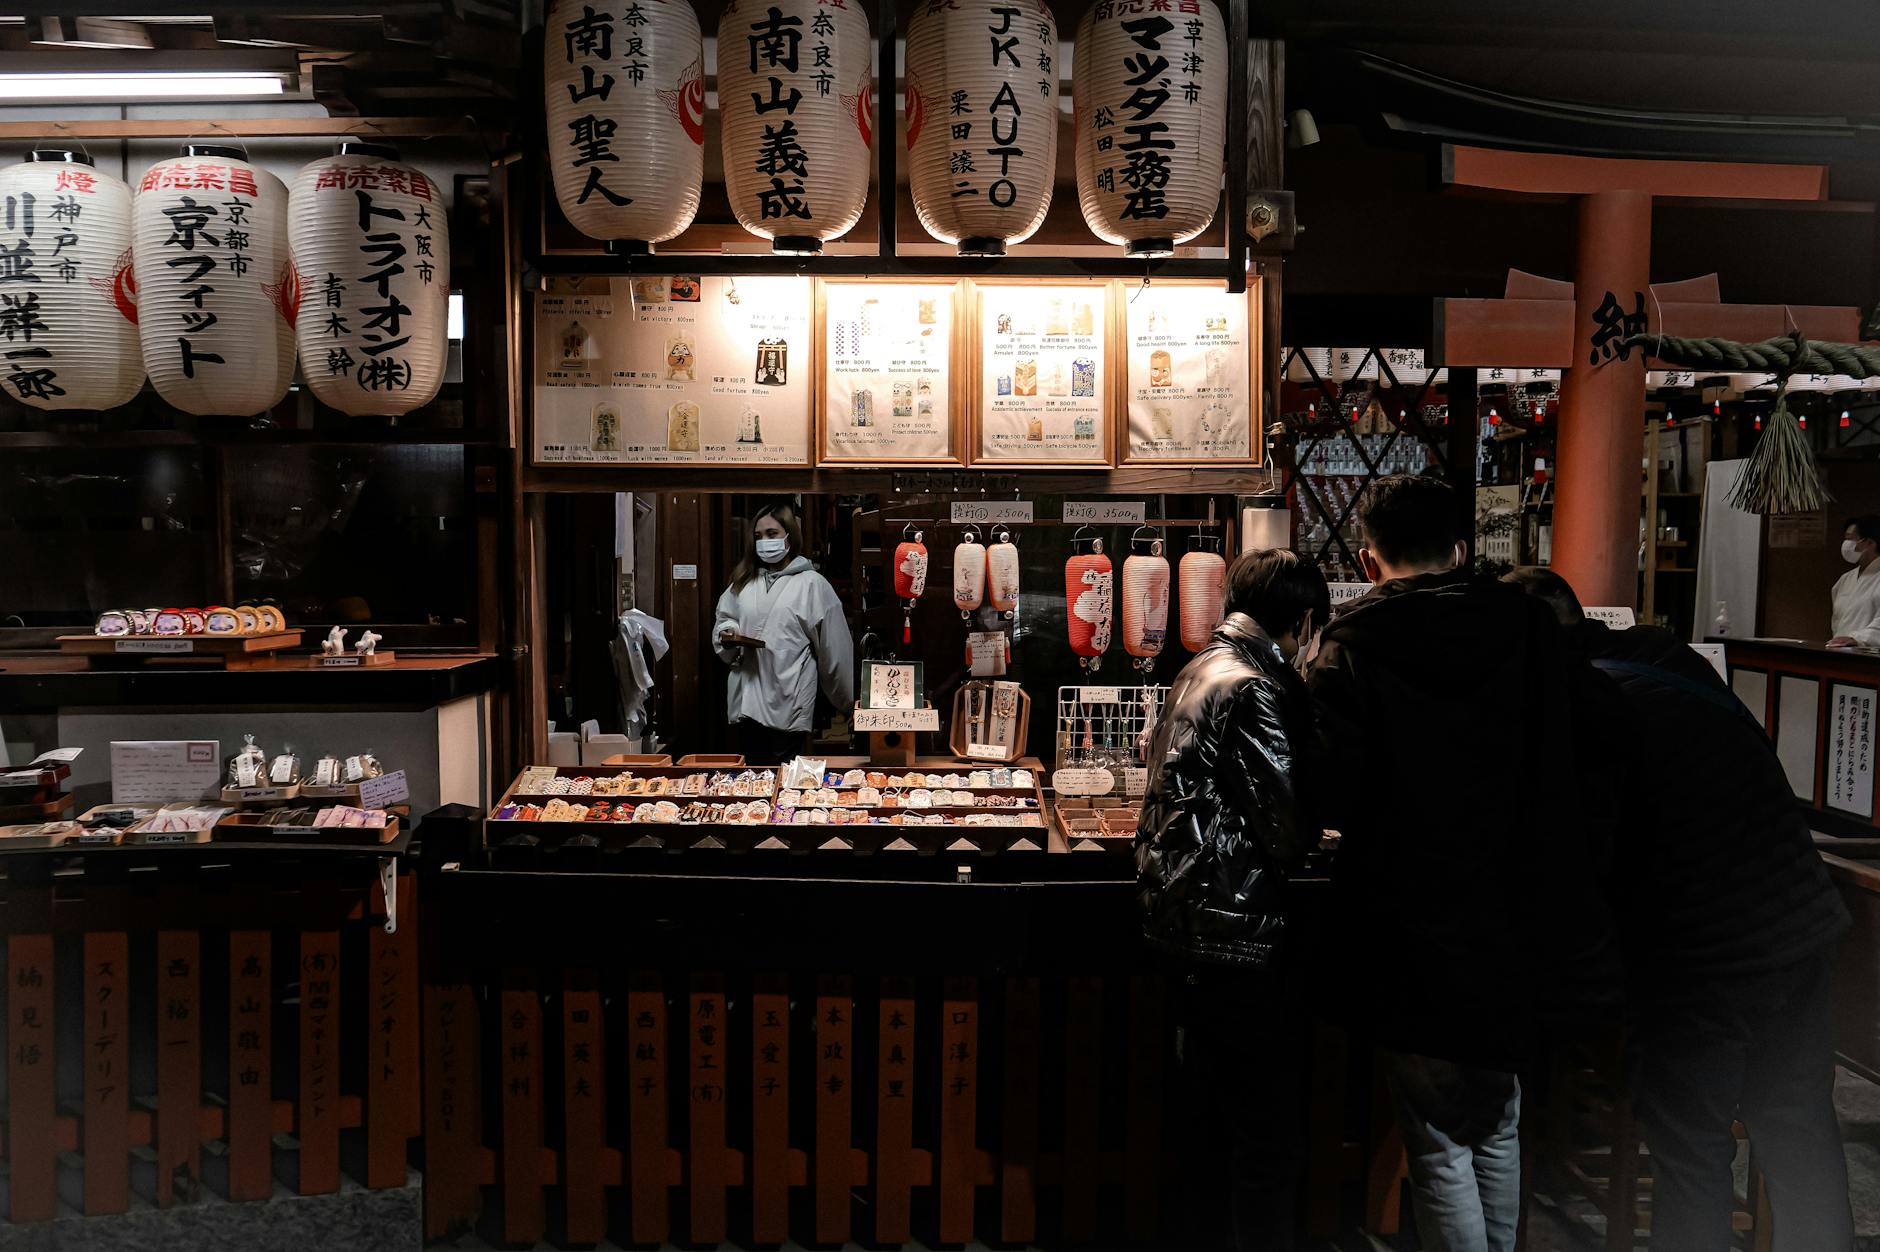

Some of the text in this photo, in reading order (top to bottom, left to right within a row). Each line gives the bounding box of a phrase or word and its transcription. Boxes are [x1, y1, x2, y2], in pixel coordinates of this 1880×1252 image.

[622, 2, 649, 88] 奈良市
[809, 8, 836, 98] 奈良市
[1036, 21, 1052, 100] 京都市
[1180, 18, 1204, 106] 草津市
[564, 6, 634, 207] 南山聖人
[747, 7, 813, 220] 南山義成
[950, 89, 979, 199] 栗田譲二
[1091, 105, 1115, 194] 松田明
[1117, 15, 1176, 220] マツダ工務店
[141, 163, 258, 197] 商売繁昌
[315, 164, 433, 203] 商売繁昌
[49, 196, 81, 284] 神戸市
[221, 196, 254, 278] 京都市
[413, 203, 437, 287] 大阪市
[161, 196, 225, 379] 京フィット
[319, 272, 356, 377] 青木幹
[1591, 291, 1648, 364] 納
[857, 714, 895, 728] 御朱印
[96, 962, 119, 1103] スクーデリア
[571, 1010, 590, 1097] 田英夫
